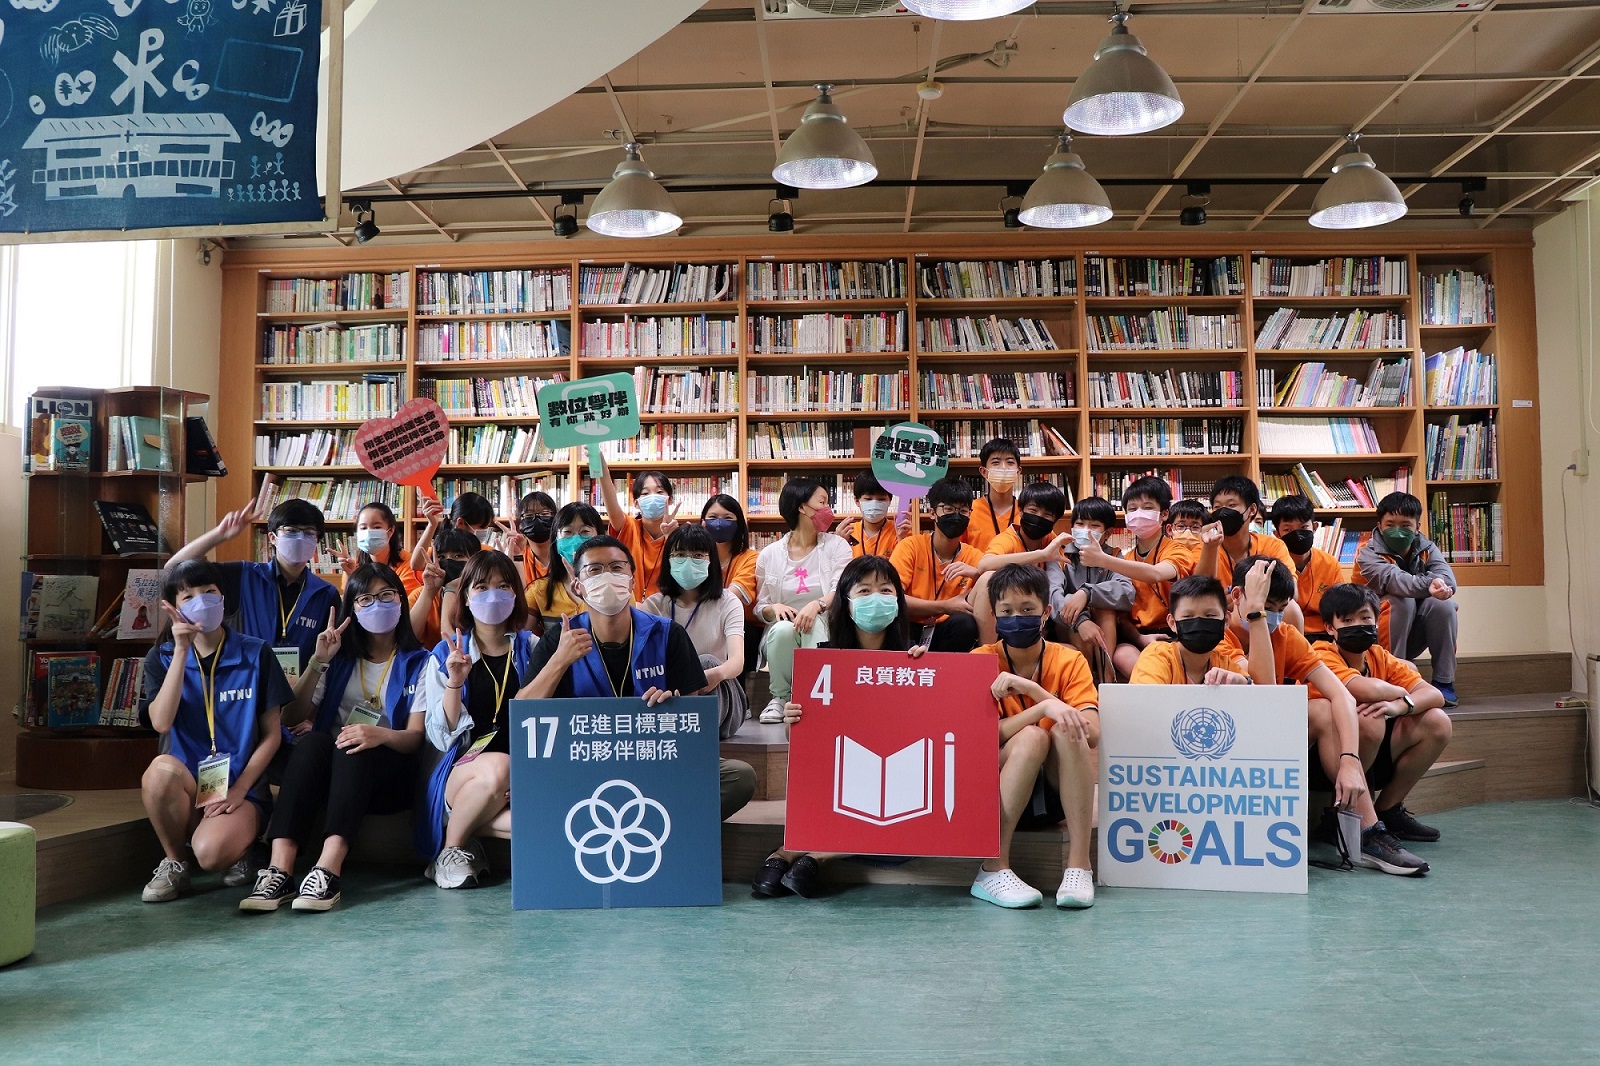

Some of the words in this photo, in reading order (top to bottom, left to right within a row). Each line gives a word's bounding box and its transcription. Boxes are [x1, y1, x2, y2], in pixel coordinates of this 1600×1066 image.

[36, 400, 89, 417] LION
[548, 391, 628, 418] 數位學伴
[367, 420, 441, 460] 用生命陪伴生命
[372, 430, 445, 470] 用生命影響生命
[875, 435, 949, 458] 數位學伴
[635, 664, 665, 680] NTNU
[810, 664, 834, 706] 4
[855, 665, 936, 687] 良質教育
[219, 688, 253, 702] NTNU
[569, 712, 701, 736] 促進目標實現
[521, 716, 559, 759] 17
[569, 739, 679, 762] 的夥伴關係
[1108, 764, 1300, 790] SUSTAINABLE
[1108, 791, 1300, 817] DEVELOPMENT
[1107, 817, 1302, 868] GOALS
